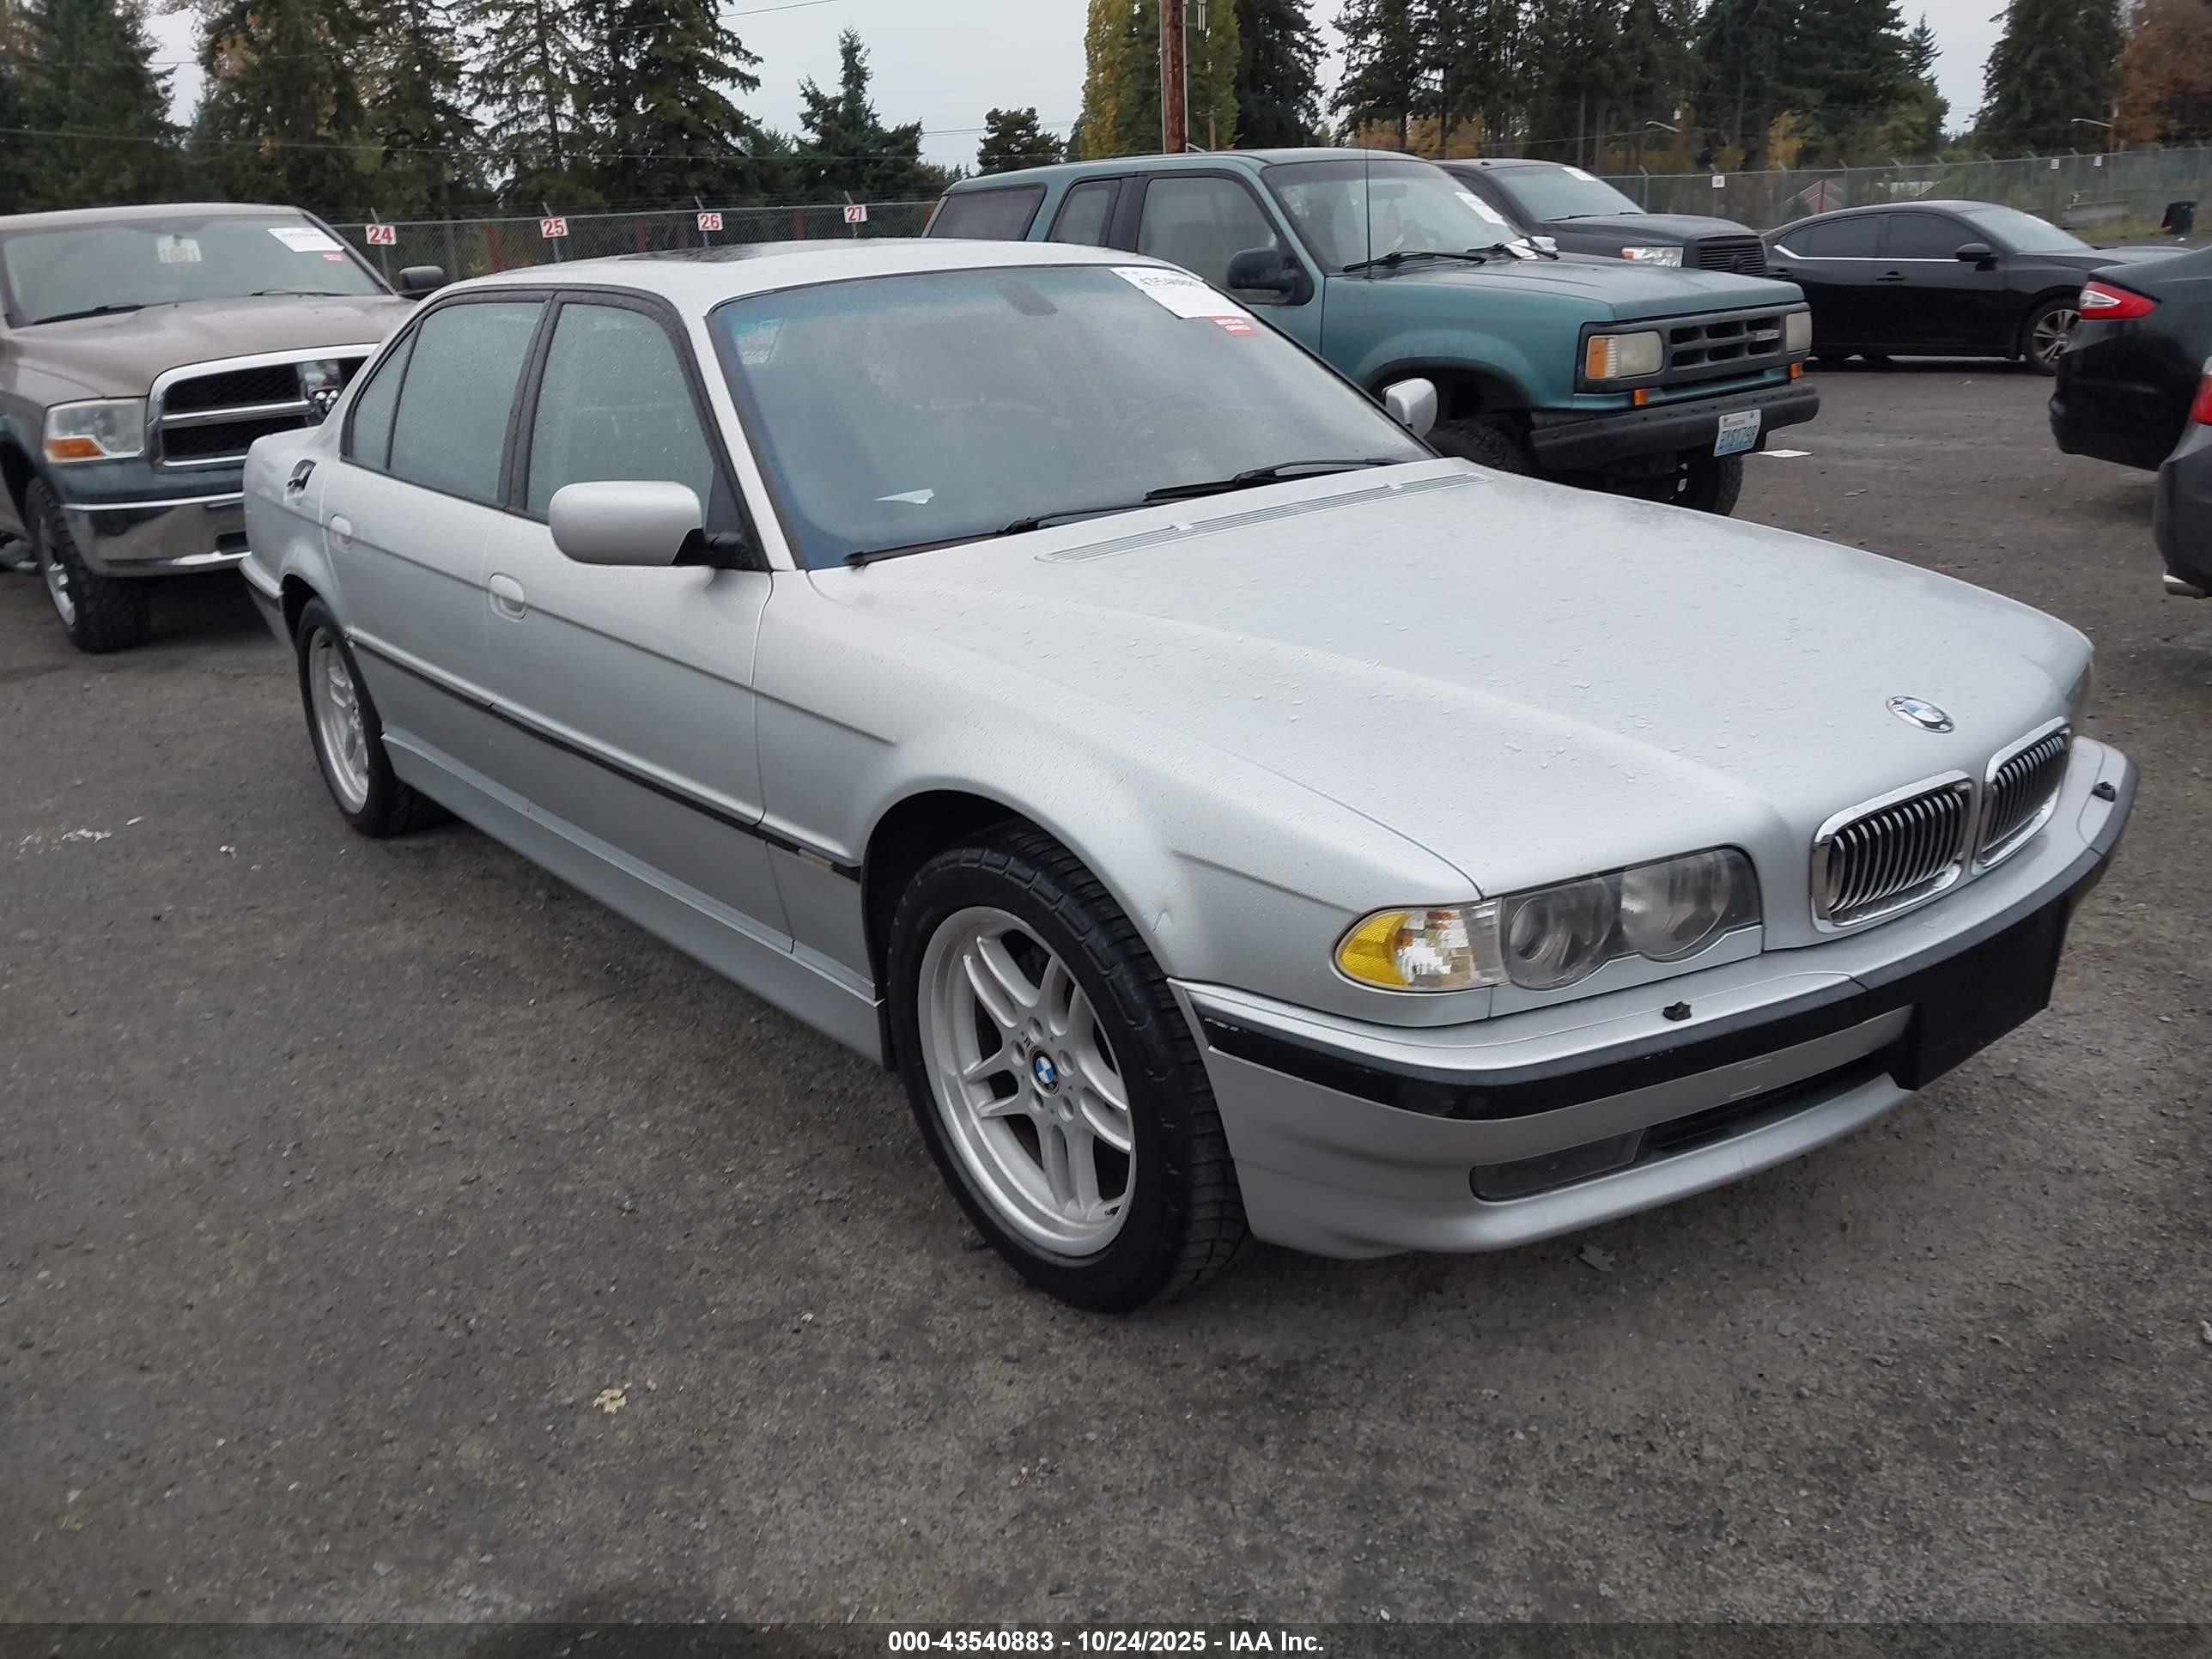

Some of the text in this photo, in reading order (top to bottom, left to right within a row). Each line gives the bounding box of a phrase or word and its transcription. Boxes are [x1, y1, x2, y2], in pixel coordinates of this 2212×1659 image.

[700, 215, 720, 229] 26
[847, 206, 863, 222] 27
[368, 226, 393, 243] 24
[542, 219, 565, 236] 25
